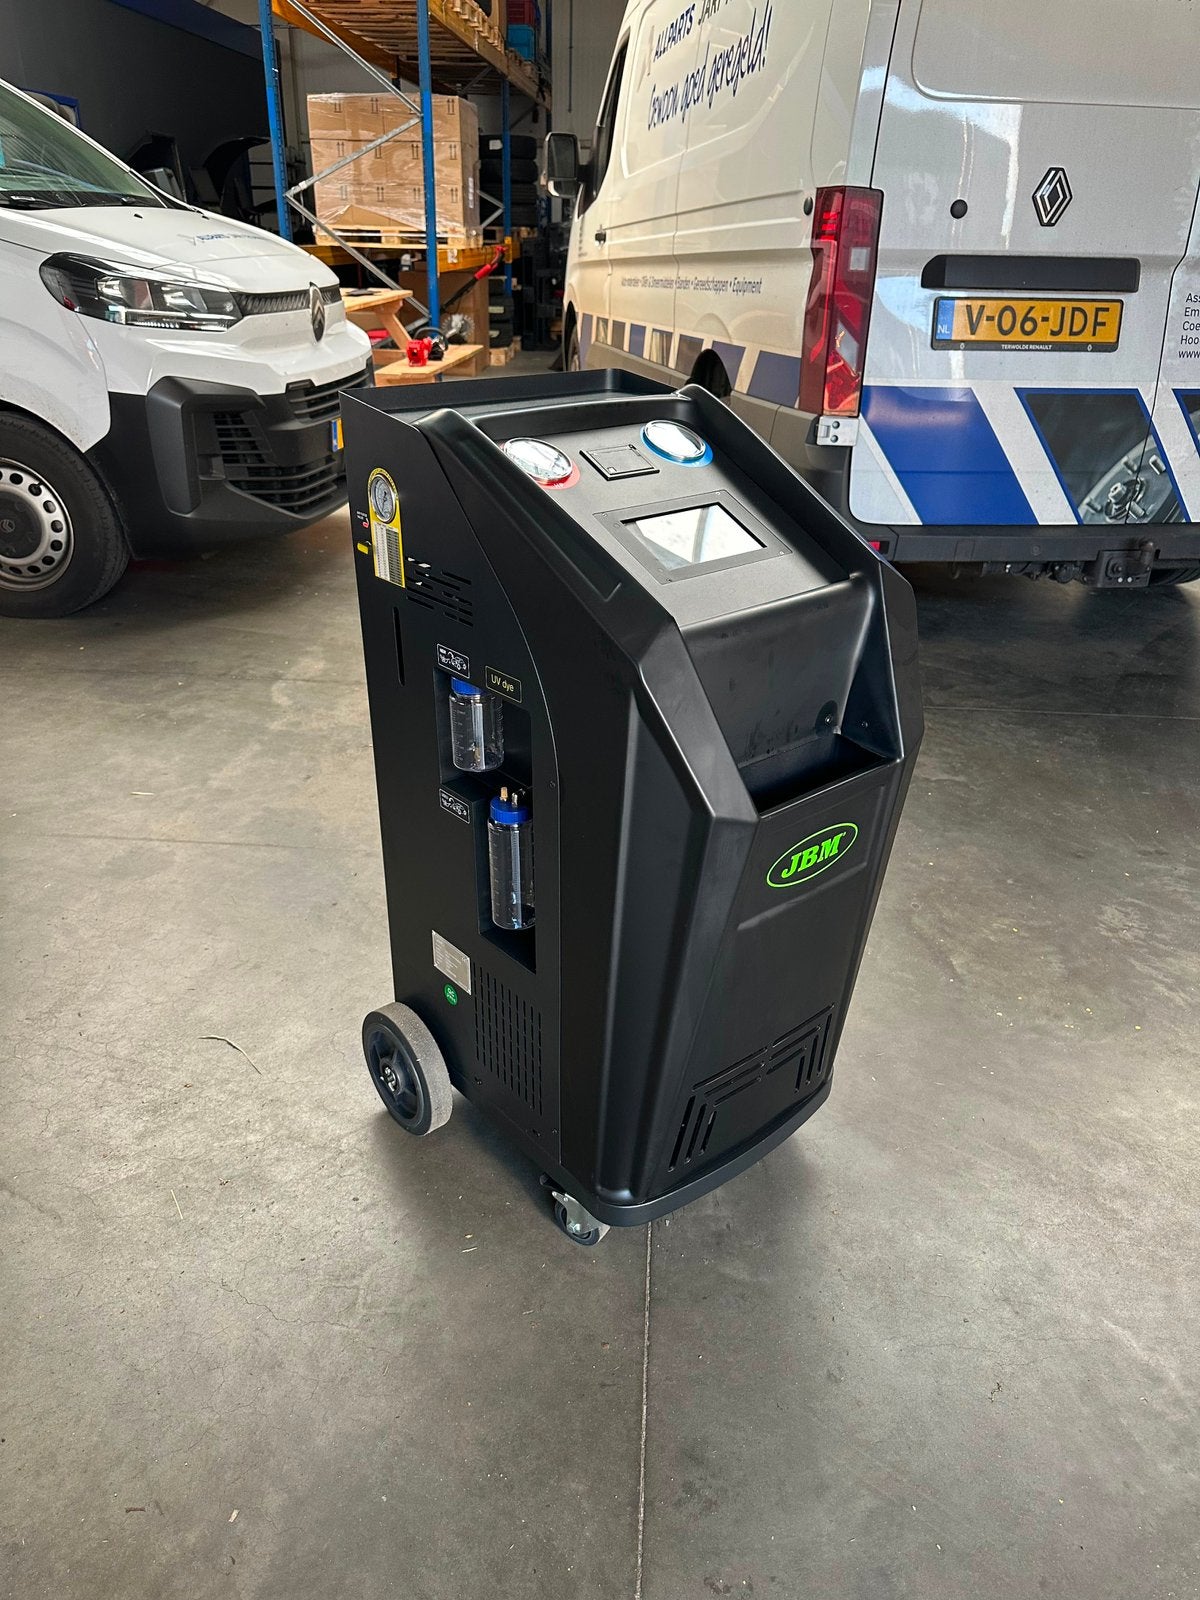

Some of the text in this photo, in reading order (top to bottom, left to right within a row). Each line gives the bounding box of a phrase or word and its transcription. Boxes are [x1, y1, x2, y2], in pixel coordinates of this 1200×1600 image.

[653, 3, 695, 62] ALLPARTS
[680, 40, 710, 123] goed
[707, 0, 773, 109] geregeld!
[732, 276, 762, 296] Equipment
[966, 304, 1109, 337] V-06-JDF
[1184, 306, 1200, 317] Em
[937, 325, 950, 334] NL
[1180, 335, 1200, 345] Hoo
[491, 673, 515, 692] UV dye
[781, 832, 846, 879] JBM
